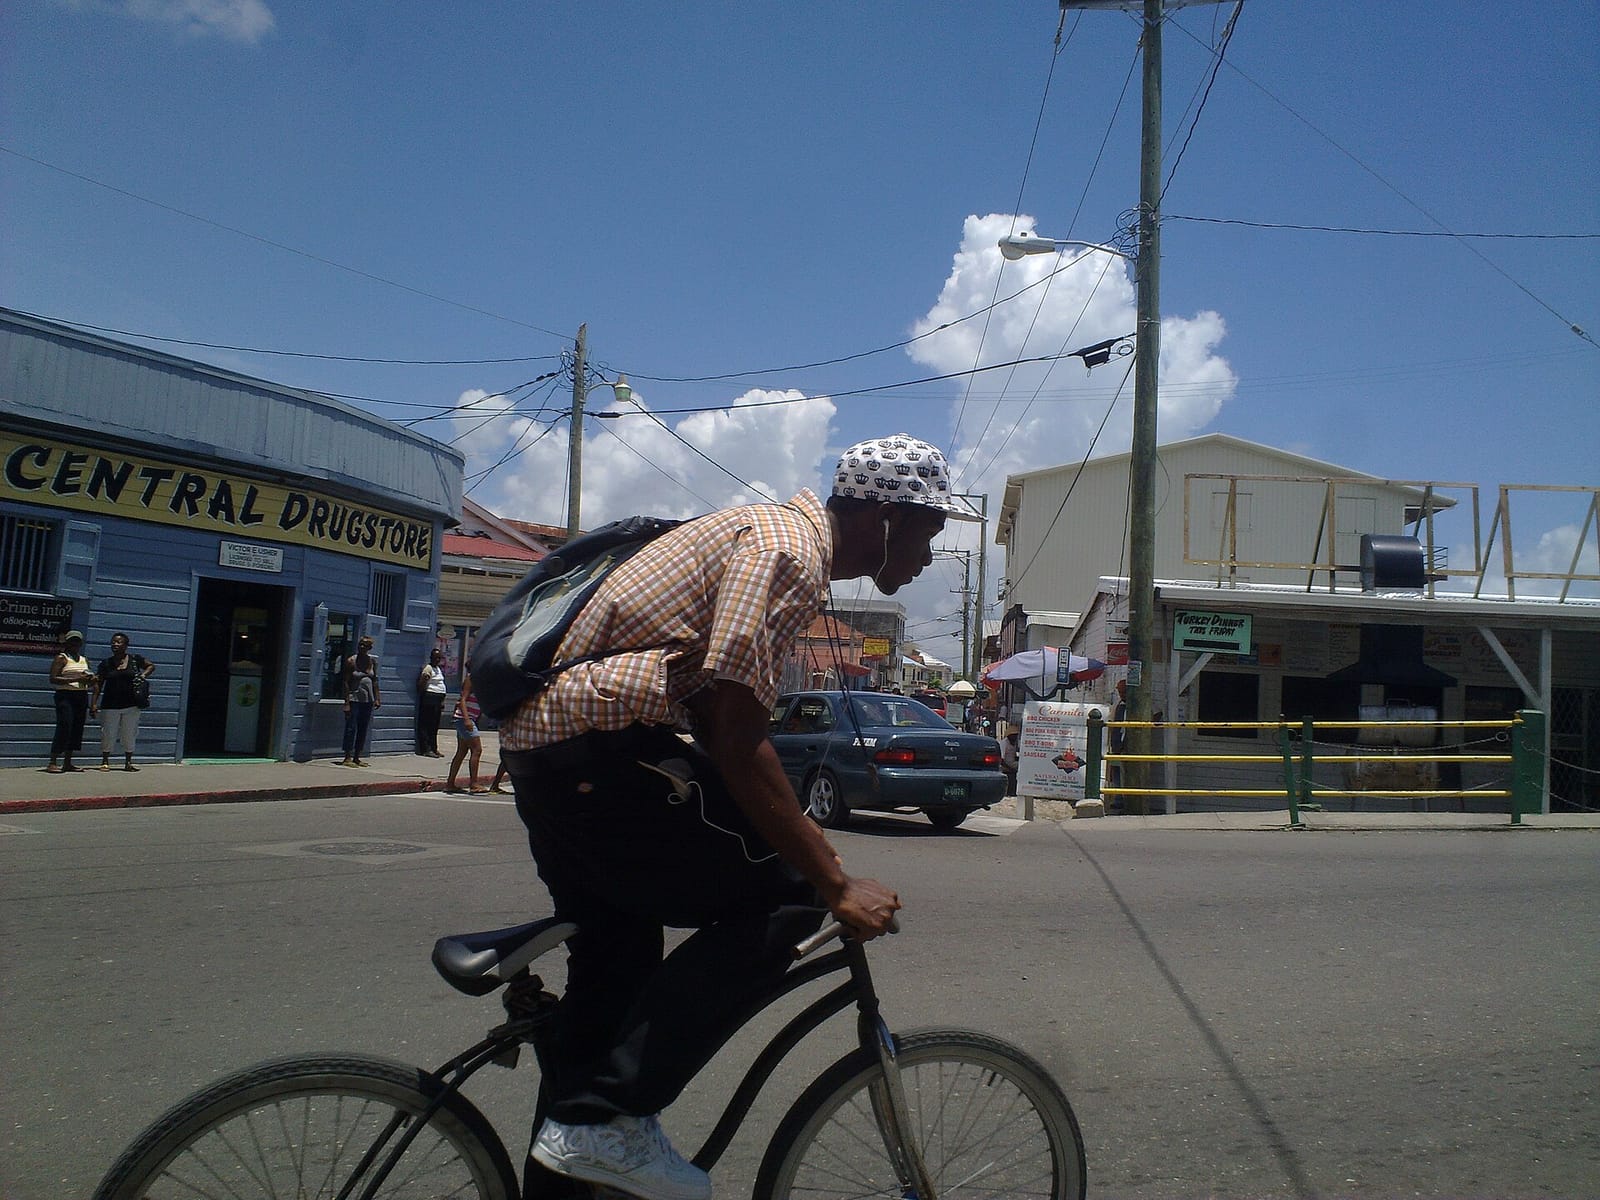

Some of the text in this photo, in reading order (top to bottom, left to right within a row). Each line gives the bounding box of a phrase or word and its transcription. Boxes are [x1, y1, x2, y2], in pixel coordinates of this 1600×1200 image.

[4, 443, 432, 561] CENTRAL DRUGSTORE
[228, 543, 251, 553] VICTOR
[0, 599, 72, 617] Crime info?
